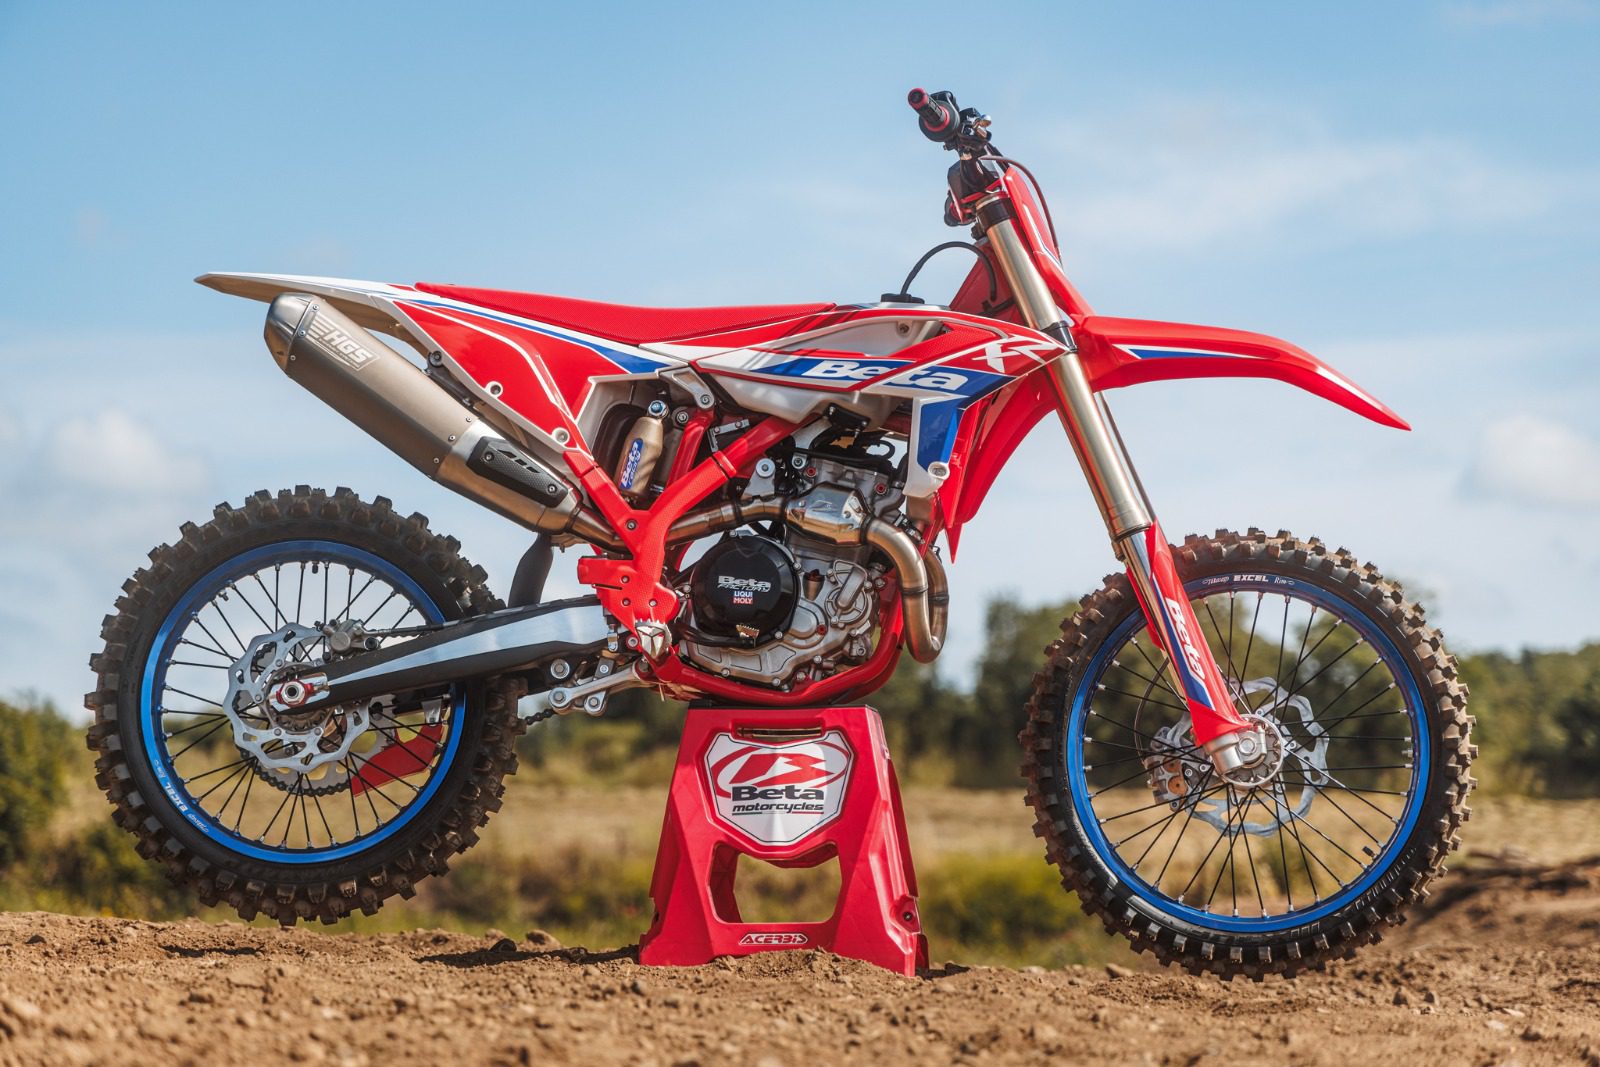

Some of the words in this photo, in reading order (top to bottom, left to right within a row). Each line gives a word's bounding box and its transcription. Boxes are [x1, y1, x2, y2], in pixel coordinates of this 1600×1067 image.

[323, 330, 374, 363] HGS
[801, 360, 969, 391] Beta
[718, 576, 771, 590] Beta
[1233, 574, 1269, 582] EXCEL
[734, 590, 753, 598] LIQUI
[1165, 597, 1206, 680] Beta
[165, 781, 189, 813] EXCEL
[732, 785, 824, 802] Beta
[732, 802, 824, 814] motorcycles
